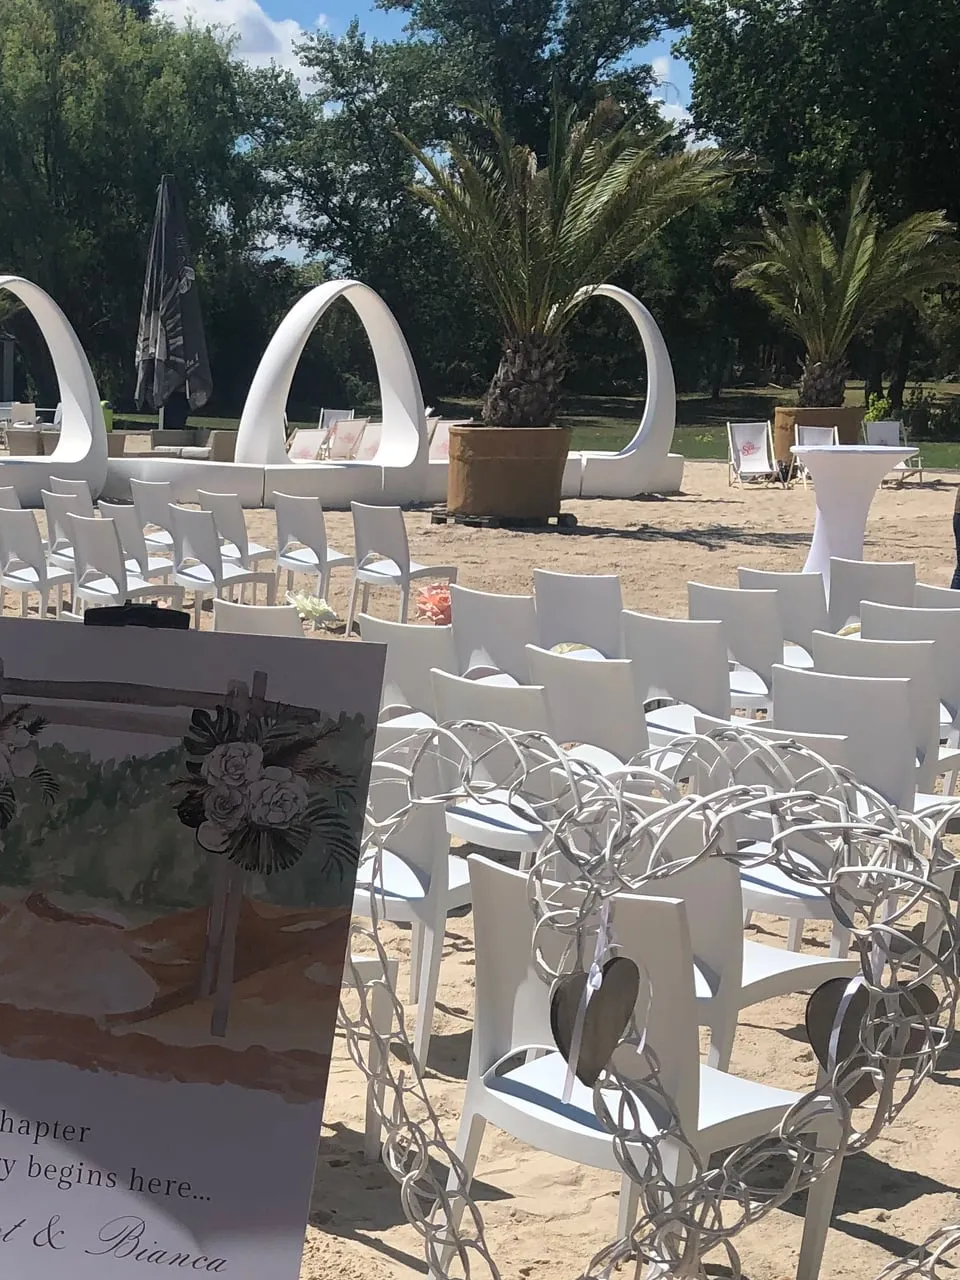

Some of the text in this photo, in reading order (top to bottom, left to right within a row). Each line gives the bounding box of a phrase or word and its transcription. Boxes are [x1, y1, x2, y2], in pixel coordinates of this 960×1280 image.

[28, 1155, 118, 1189] begins
[129, 1168, 211, 1201] here...
[33, 1215, 66, 1250] &
[85, 1216, 227, 1273] Bianca
